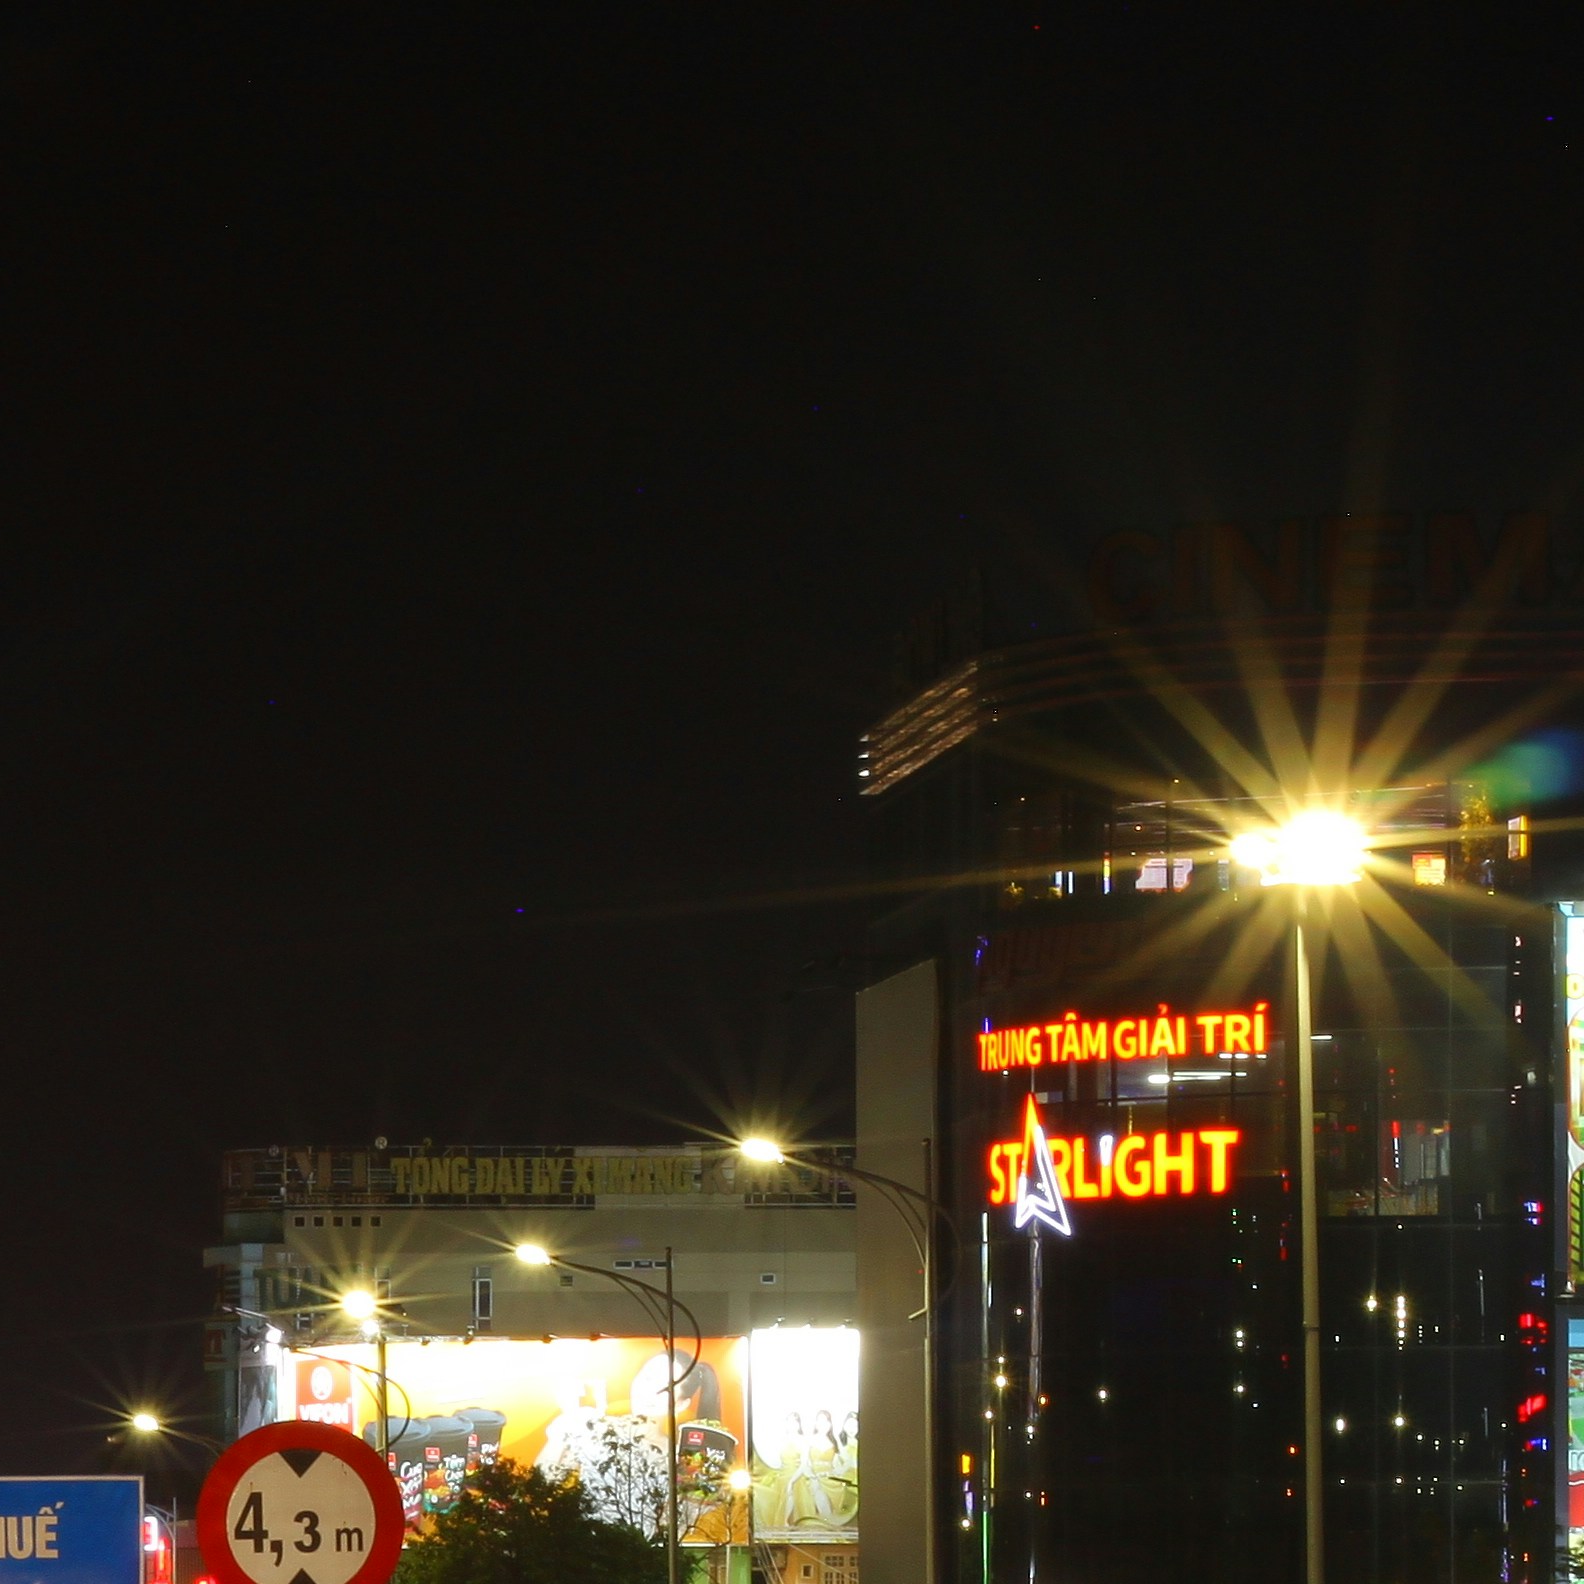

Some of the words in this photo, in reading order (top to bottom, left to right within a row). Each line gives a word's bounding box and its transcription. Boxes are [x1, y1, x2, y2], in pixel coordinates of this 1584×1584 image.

[980, 1026, 1042, 1071] TRUNG
[1045, 1012, 1108, 1062] TÂM
[1113, 1003, 1187, 1059] GIẢI
[1196, 1003, 1268, 1053] TRÍ
